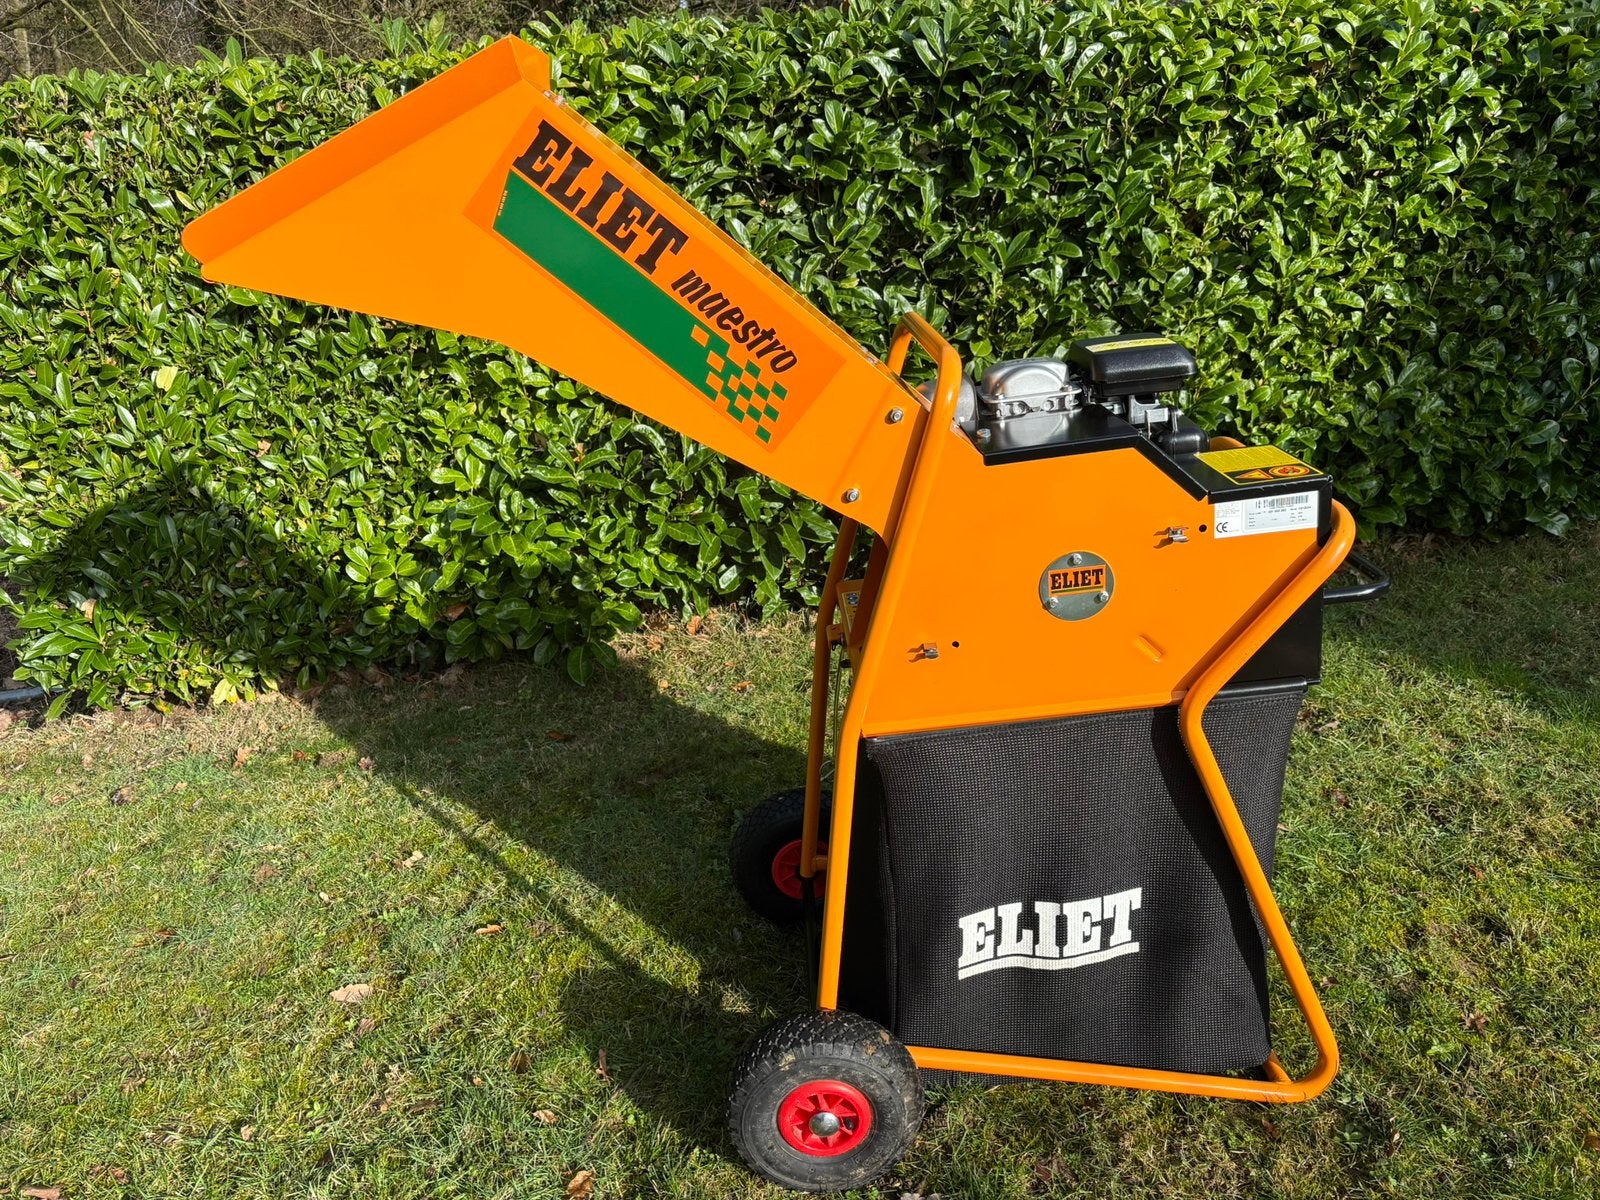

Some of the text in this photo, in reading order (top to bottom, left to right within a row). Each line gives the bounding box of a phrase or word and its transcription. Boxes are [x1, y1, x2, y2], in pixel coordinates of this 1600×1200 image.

[512, 119, 798, 374] ELIET maestro
[1050, 568, 1104, 590] ELIET
[958, 887, 1142, 969] ELIET
